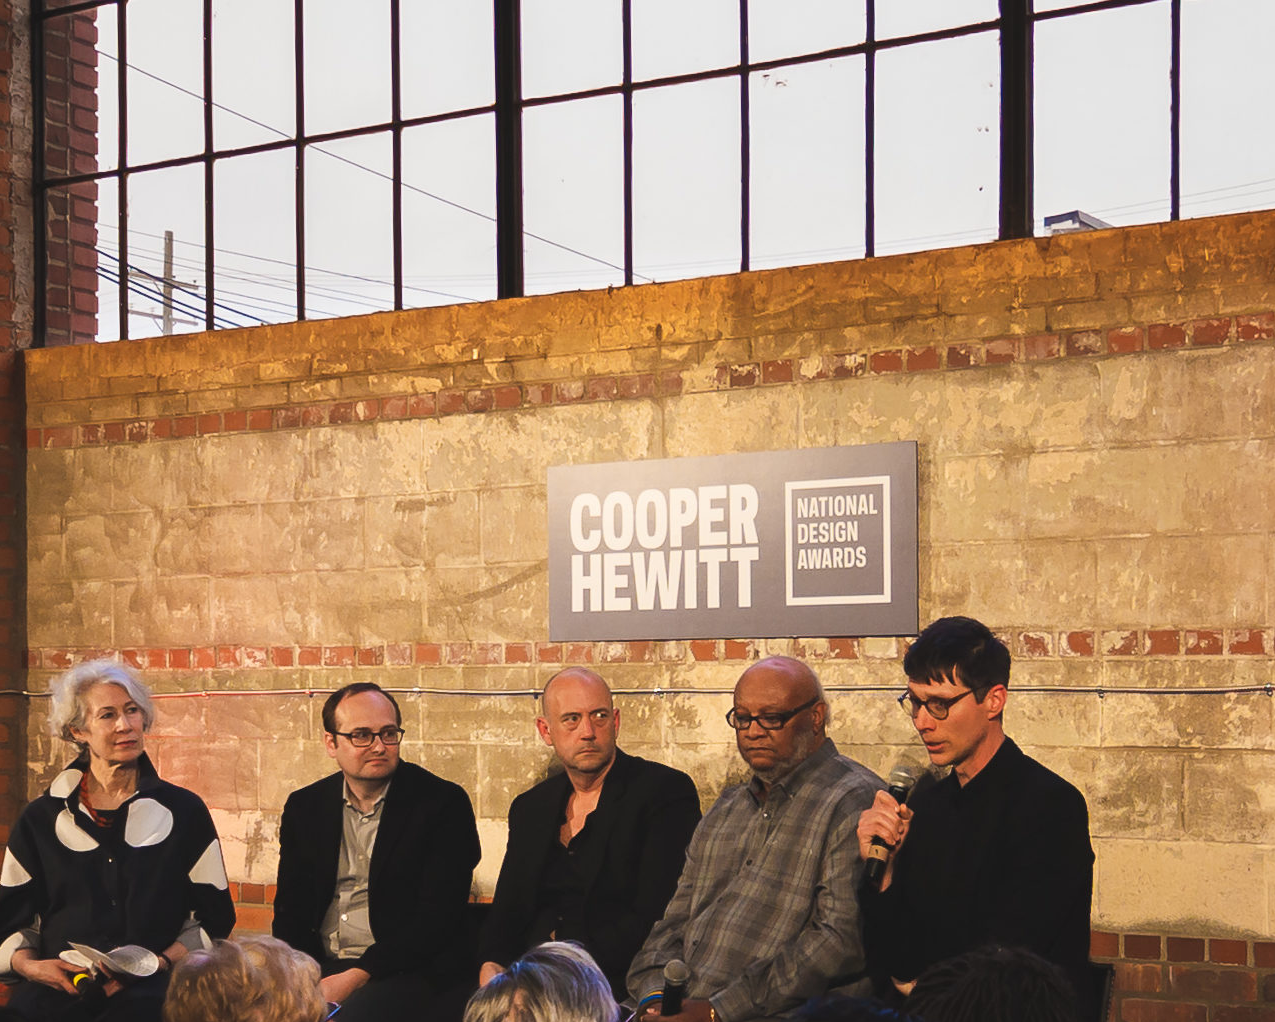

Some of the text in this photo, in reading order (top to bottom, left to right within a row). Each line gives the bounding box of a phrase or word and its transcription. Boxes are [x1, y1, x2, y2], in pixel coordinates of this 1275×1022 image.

[571, 484, 758, 551] COOPER
[797, 493, 877, 518] NATIONAL
[797, 520, 858, 544] DESIGN
[797, 547, 867, 569] AWARDS
[571, 546, 759, 612] HEWITT
